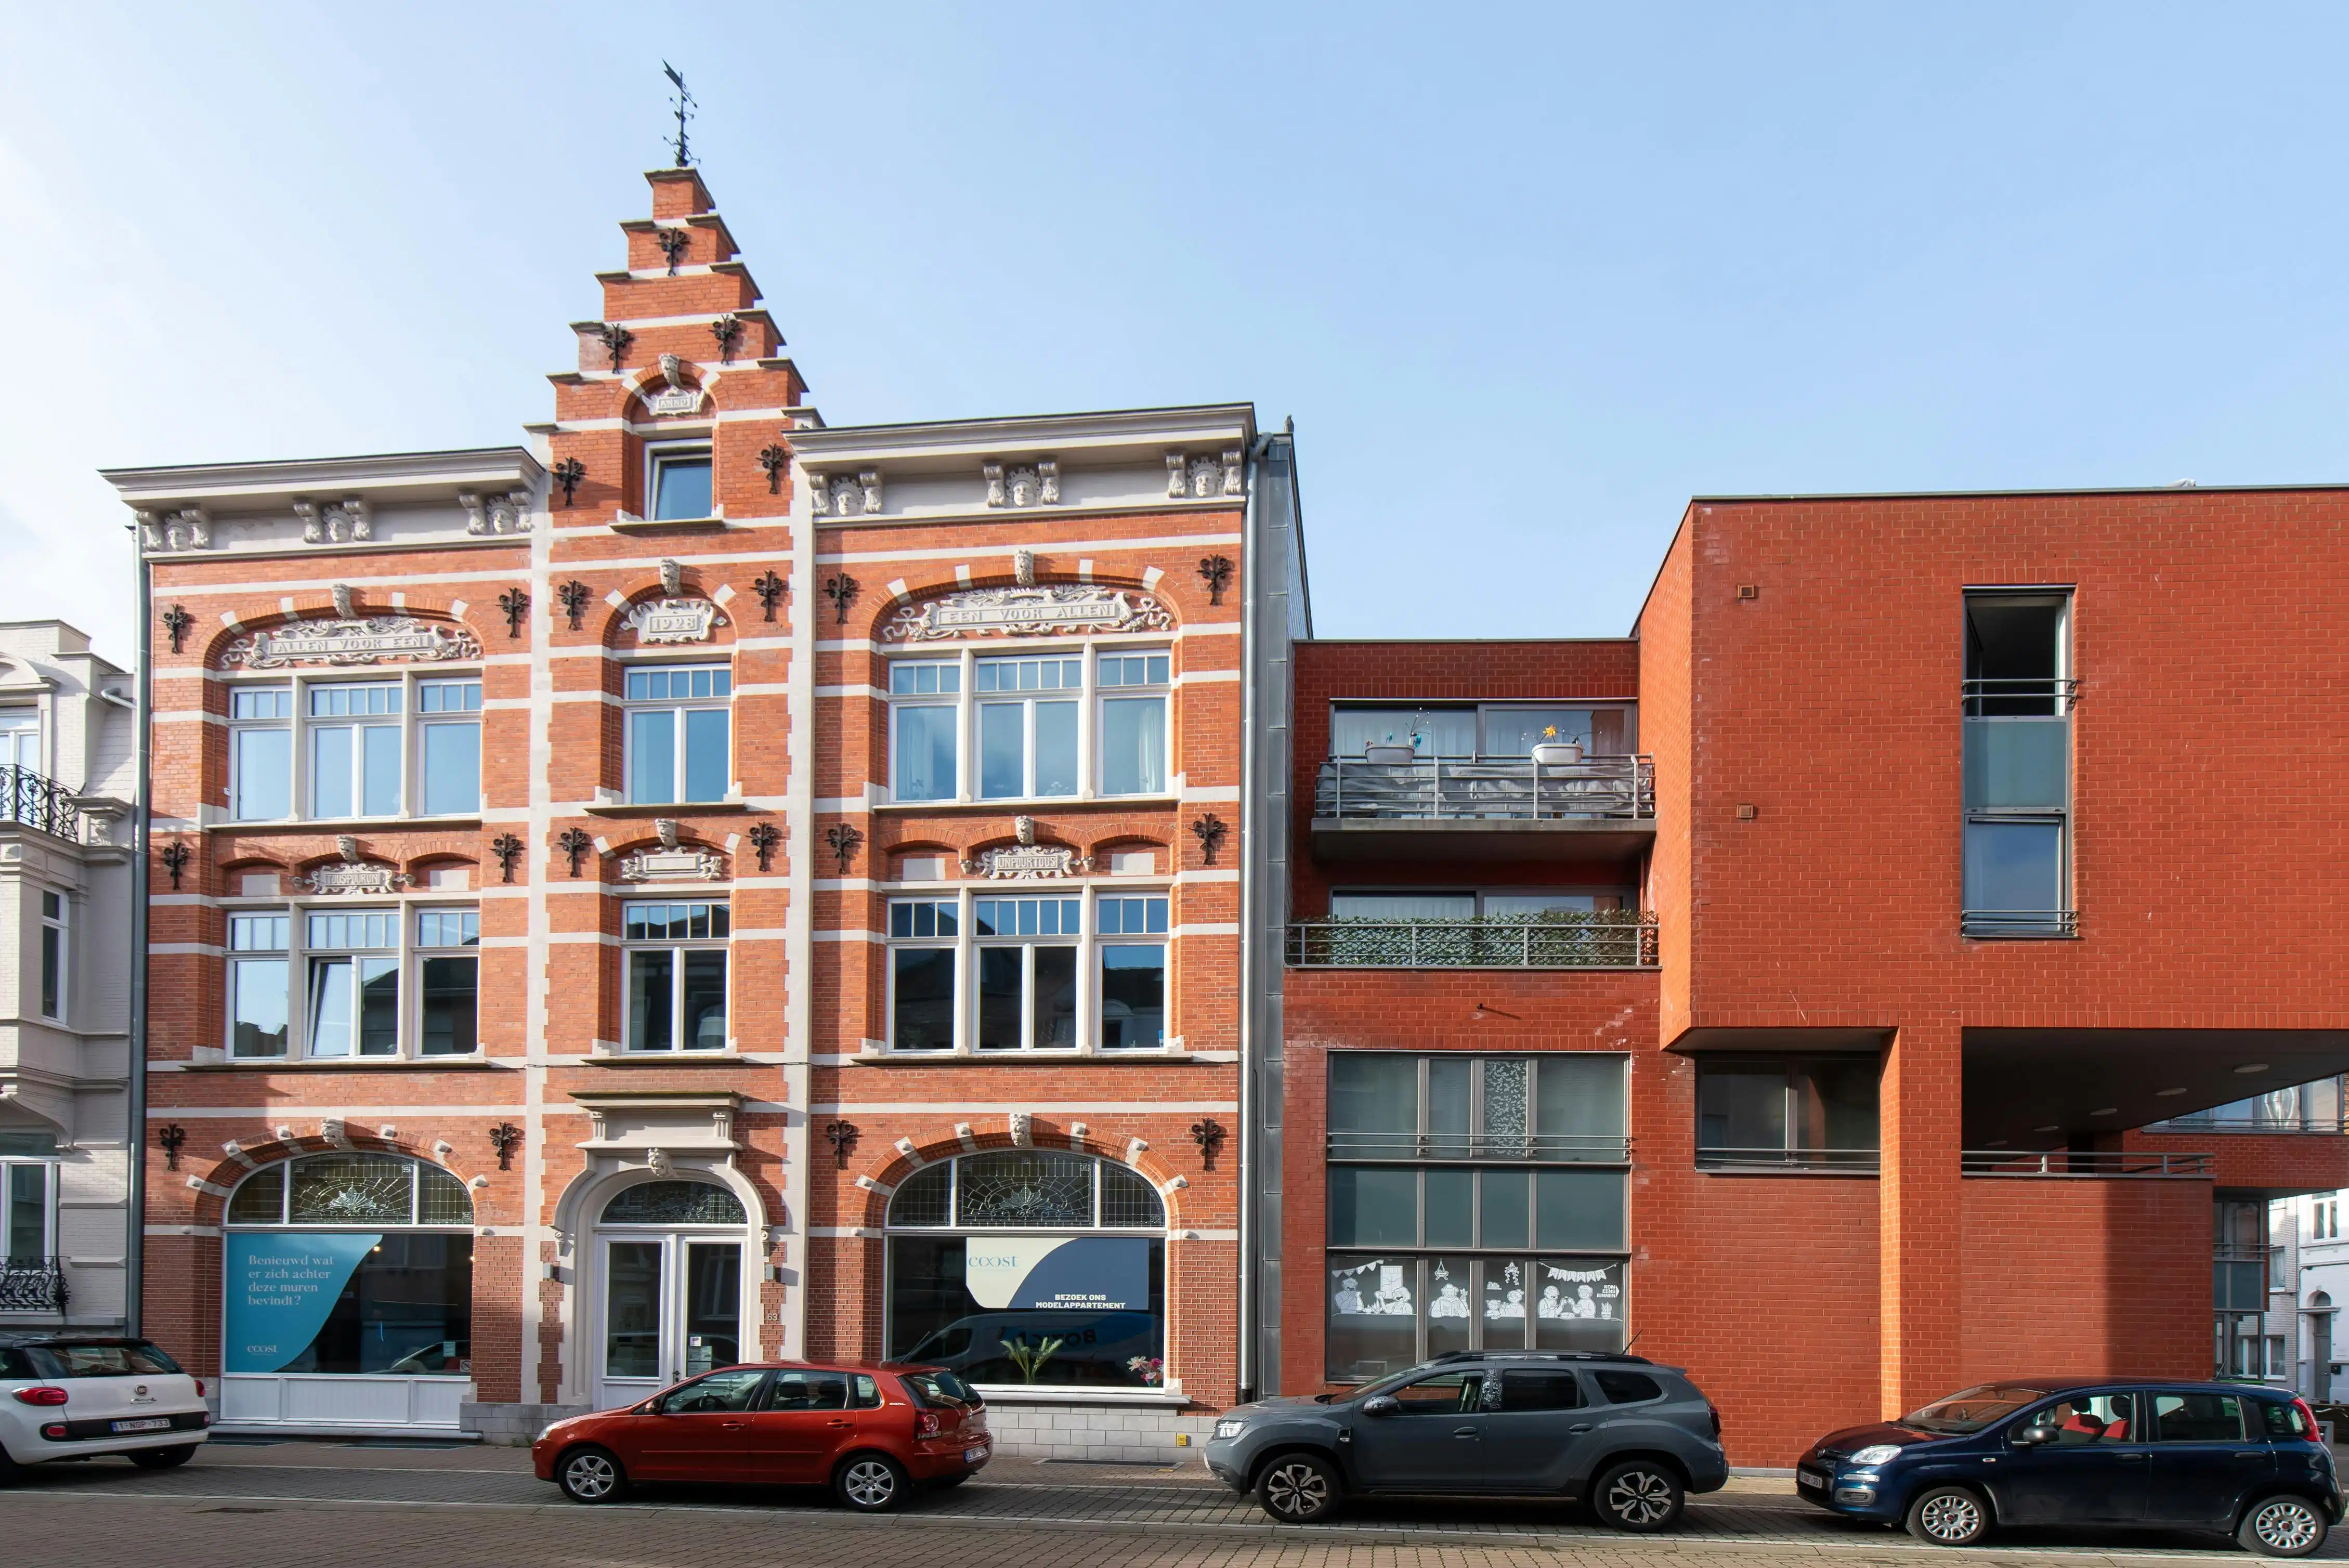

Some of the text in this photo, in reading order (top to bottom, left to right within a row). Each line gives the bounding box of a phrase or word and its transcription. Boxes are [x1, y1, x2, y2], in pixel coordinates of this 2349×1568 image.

[949, 604, 1111, 622] EEN VOOR ALLEN
[277, 636, 423, 652] ALLEN VOOR EEN
[249, 1255, 334, 1265] Benieuwd wat
[969, 1256, 1019, 1267] coost
[265, 1269, 288, 1278] zich
[293, 1269, 331, 1278] achter
[249, 1282, 277, 1292] deze
[248, 1295, 301, 1305] bevindt?
[767, 1313, 777, 1321] 63
[119, 1420, 169, 1430] 1-NGP-733
